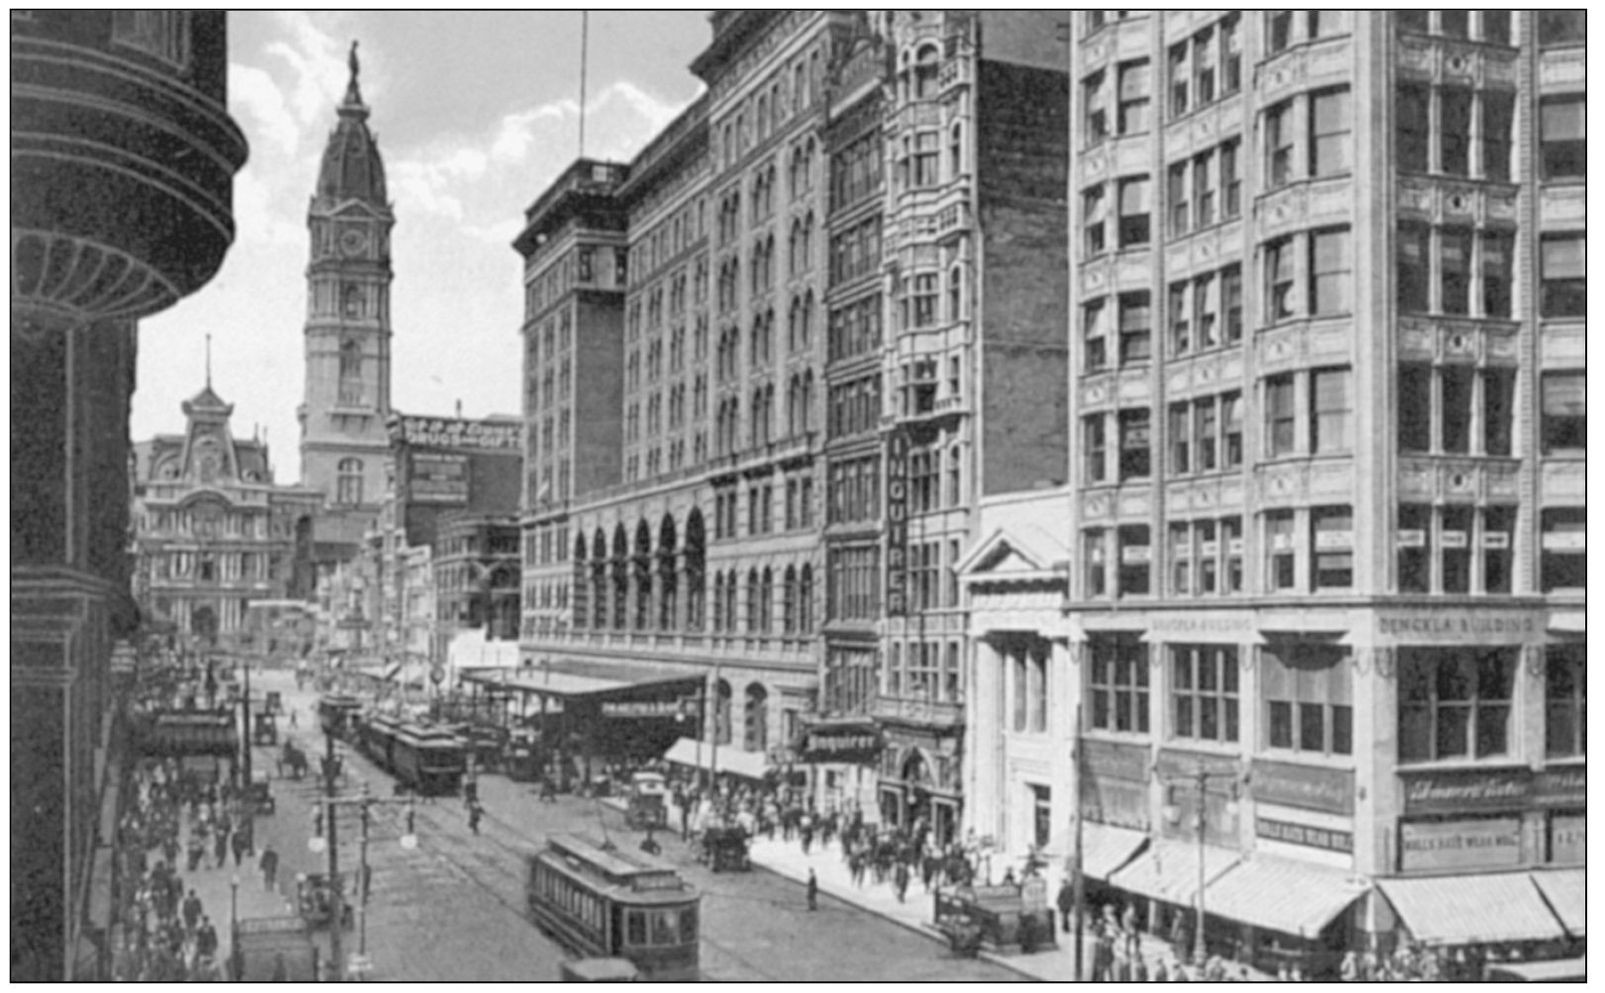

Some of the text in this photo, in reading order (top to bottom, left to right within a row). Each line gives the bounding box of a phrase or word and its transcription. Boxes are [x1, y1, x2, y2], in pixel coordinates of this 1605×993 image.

[889, 438, 905, 614] INQUIRER
[1379, 616, 1534, 634] DENCKLA BUILDING
[806, 734, 875, 753] Inquirer
